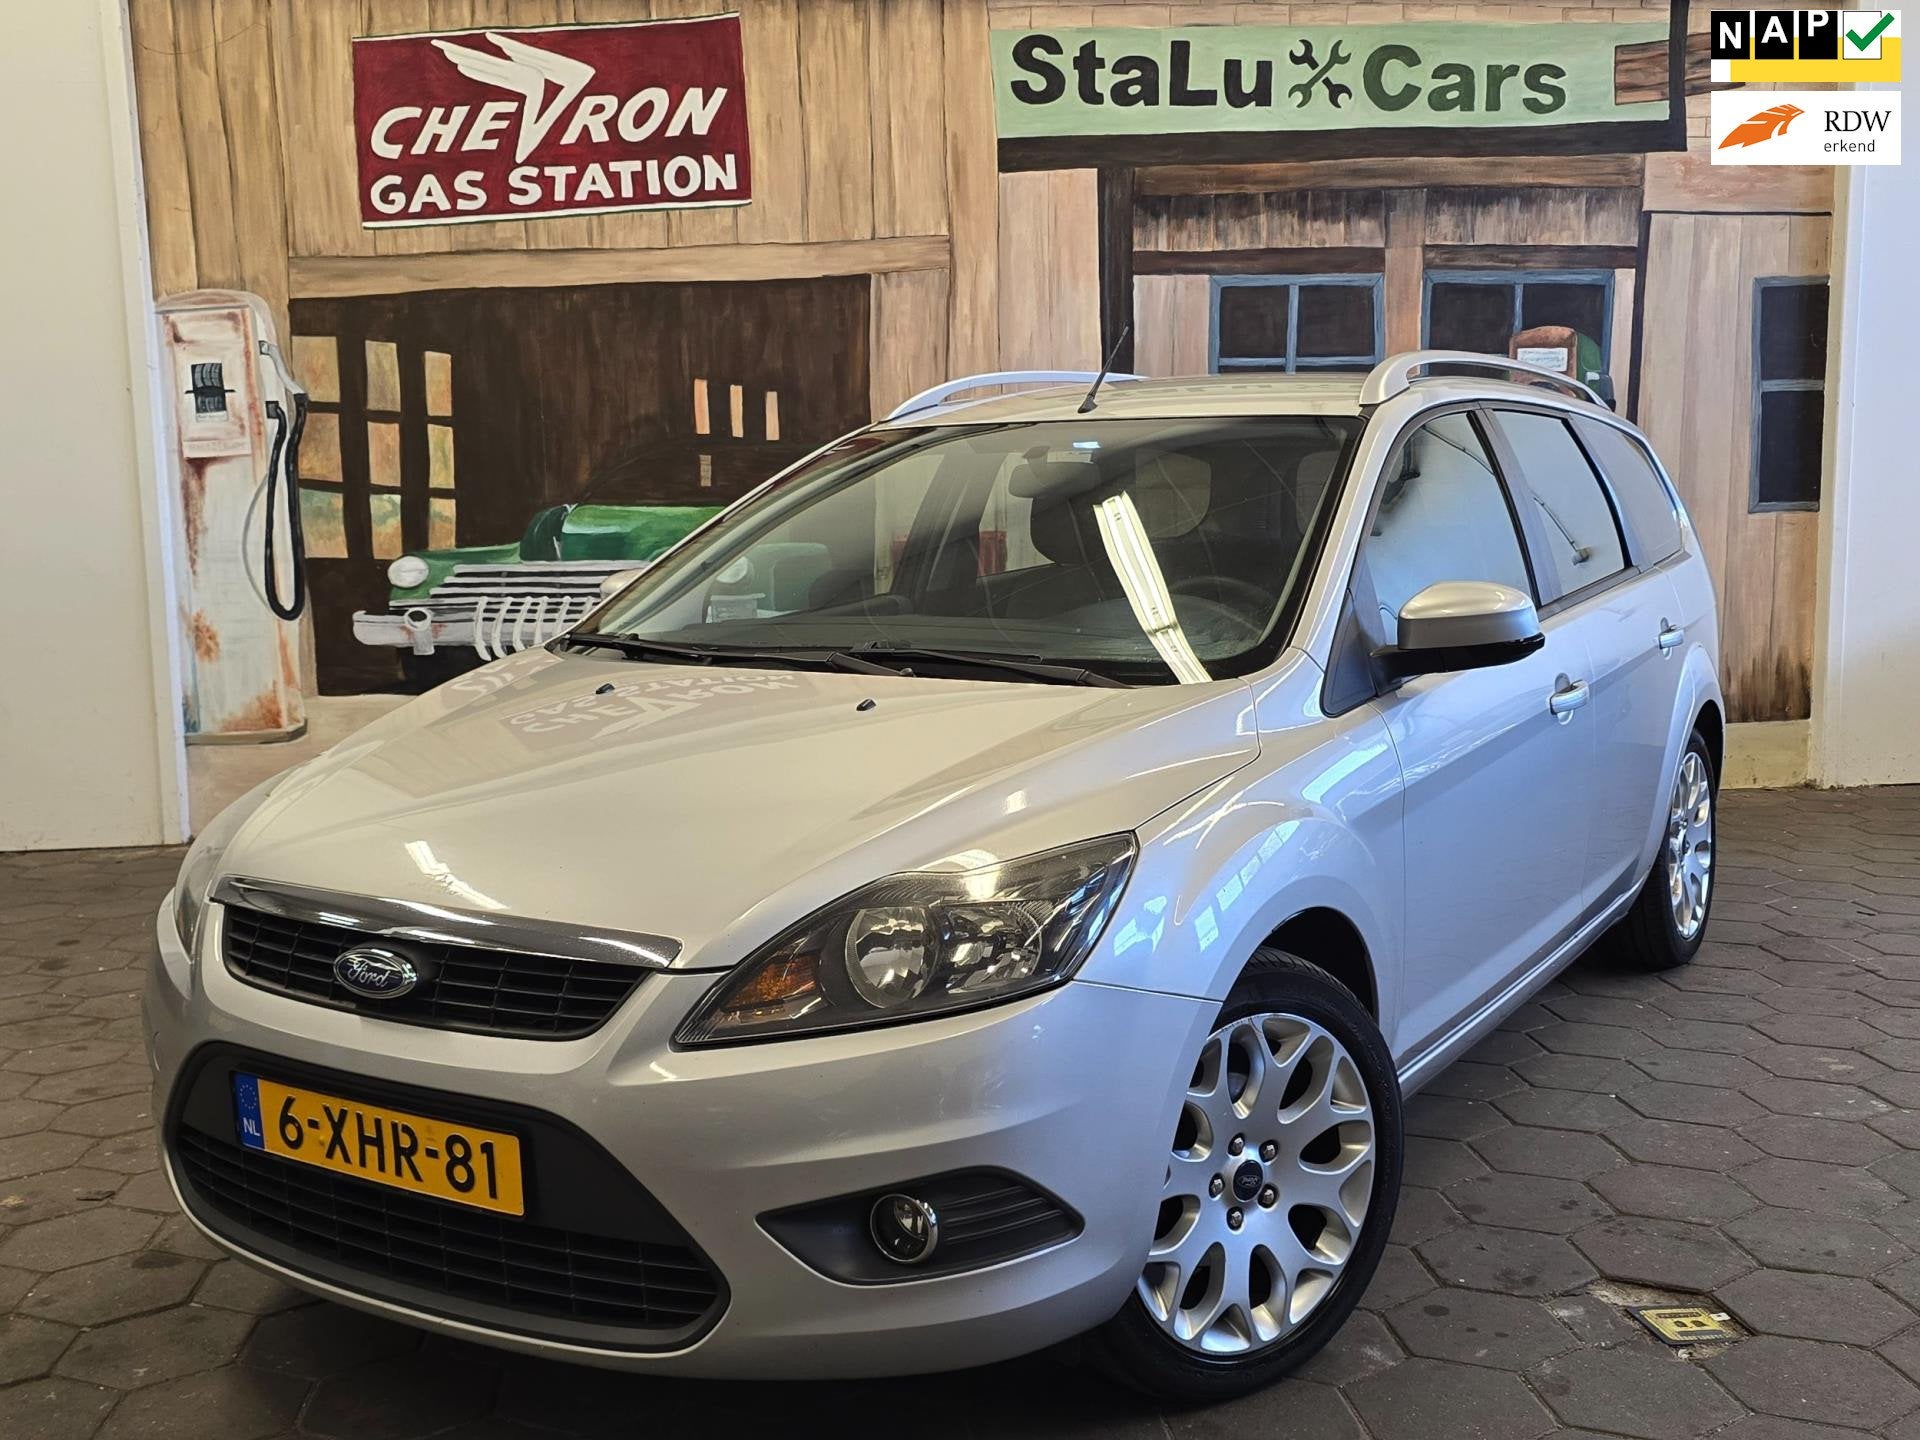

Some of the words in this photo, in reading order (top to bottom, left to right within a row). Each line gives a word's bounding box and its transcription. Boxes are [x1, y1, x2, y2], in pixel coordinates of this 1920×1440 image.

[1009, 34, 1273, 108] StaLu
[1362, 44, 1567, 114] Cars
[370, 62, 728, 163] CHEVRON
[370, 170, 487, 214] GAS
[508, 153, 738, 205] STATION
[347, 958, 399, 987] Ford
[243, 1117, 260, 1136] NL
[278, 1095, 498, 1200] 6-XHR-81
